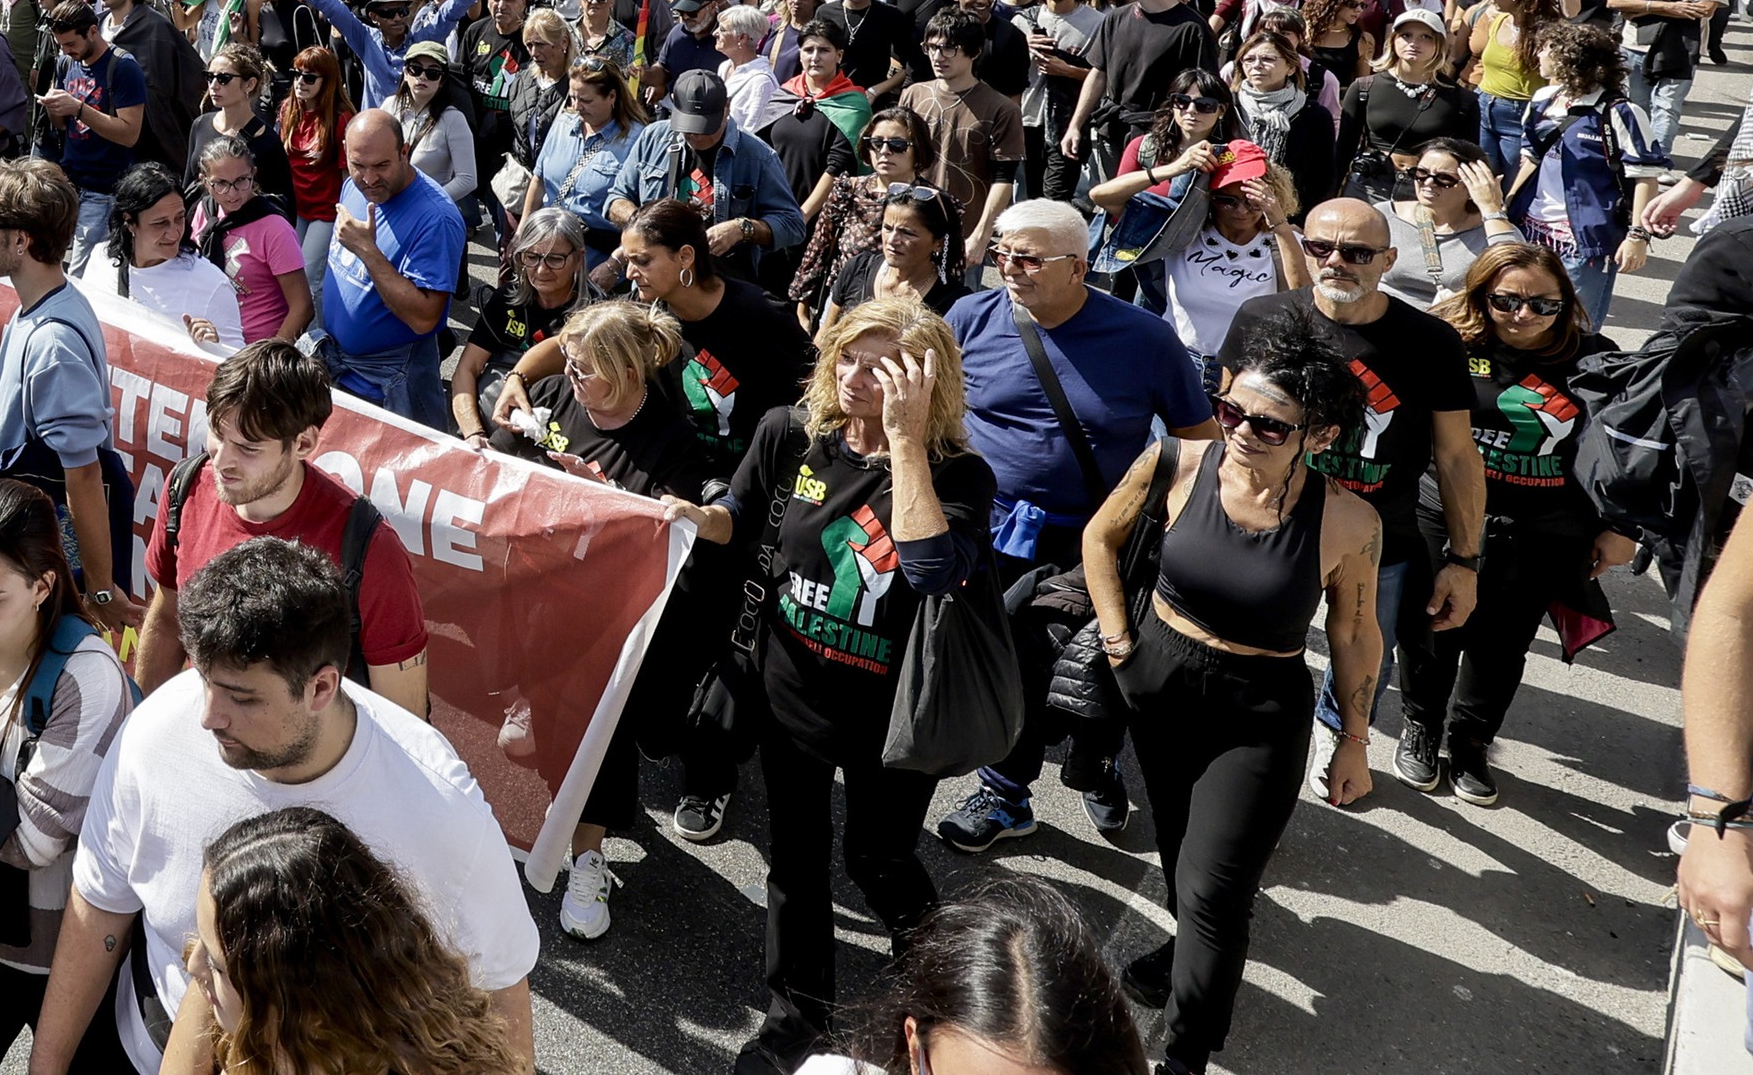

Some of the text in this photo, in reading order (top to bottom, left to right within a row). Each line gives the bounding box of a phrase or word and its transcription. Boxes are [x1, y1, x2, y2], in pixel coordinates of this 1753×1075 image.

[1187, 250, 1273, 289] Magic
[1468, 357, 1492, 374] SB
[794, 473, 827, 502] USB
[788, 570, 831, 612] REE
[778, 592, 893, 664] PALESTINE
